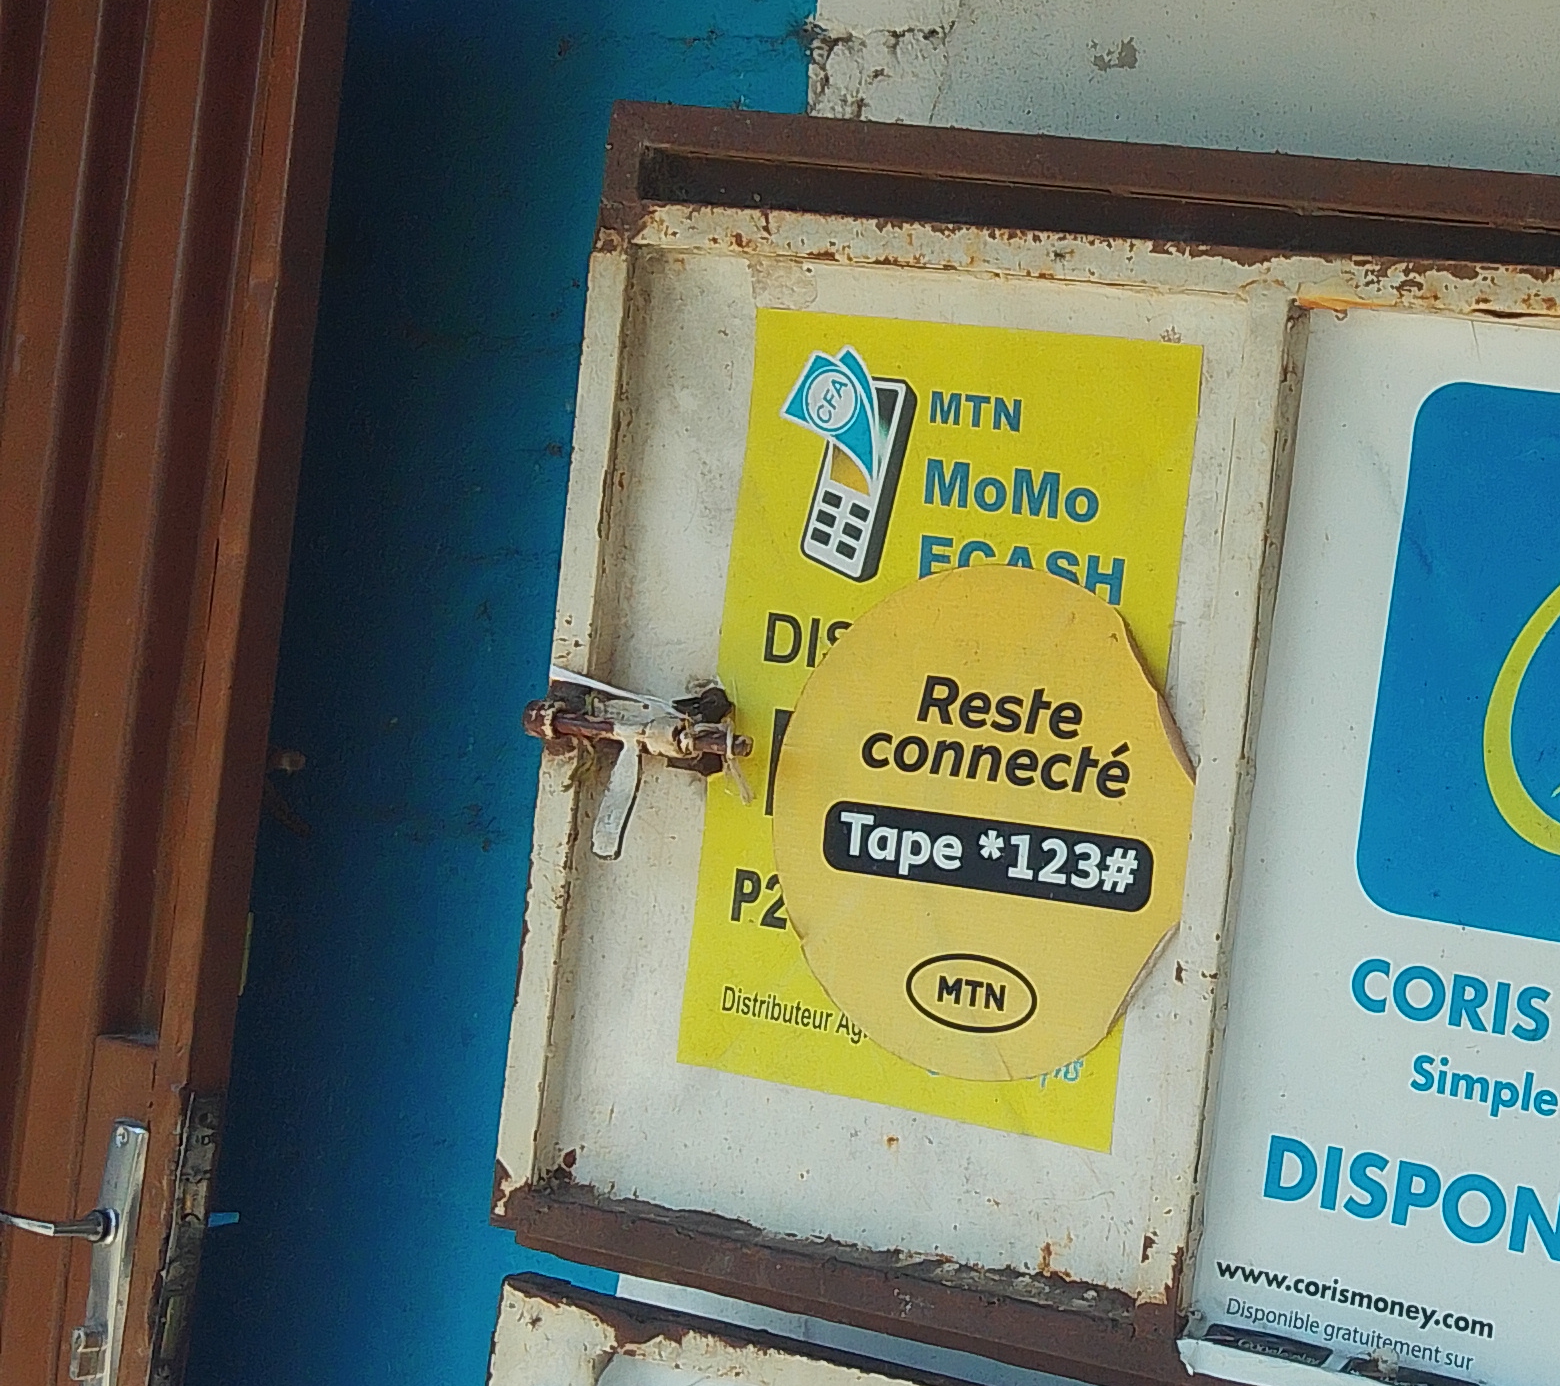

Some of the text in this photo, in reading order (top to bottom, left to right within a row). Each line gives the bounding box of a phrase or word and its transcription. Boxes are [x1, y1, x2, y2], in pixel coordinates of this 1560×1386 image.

[816, 379, 848, 423] CFA
[930, 391, 1022, 432] MTN
[924, 458, 1099, 522] MoMo
[917, 676, 1083, 740] Reste
[863, 731, 1131, 800] connecté
[839, 812, 964, 874] Tape
[722, 986, 833, 1031] Distributeur
[937, 975, 1006, 1012] MTN
[1351, 959, 1551, 1042] CORIS
[1410, 1054, 1558, 1117] Simple
[1217, 1261, 1494, 1338] www.corismoney.com
[1226, 1298, 1320, 1334] Disponible
[1324, 1321, 1442, 1363] gratuitement
[1446, 1353, 1474, 1370] sur
